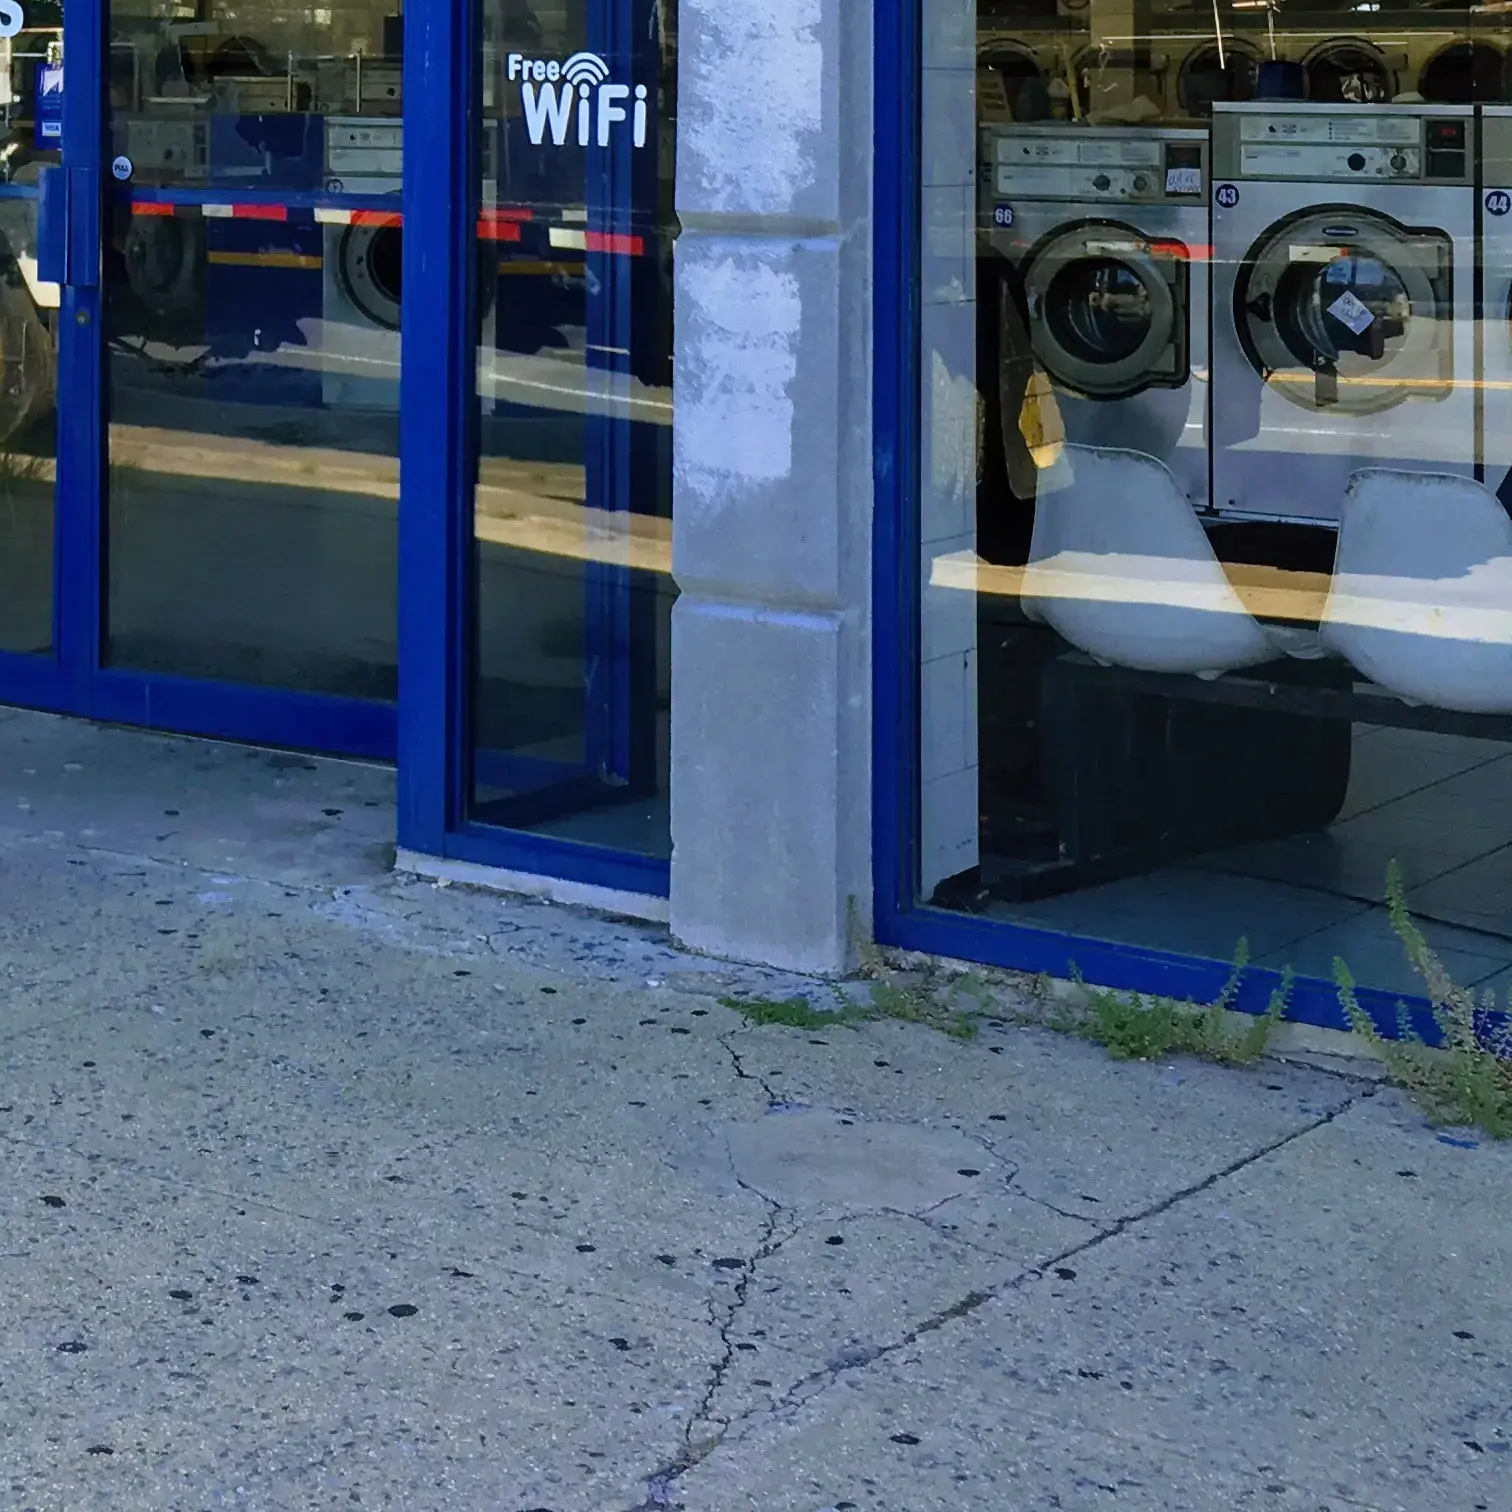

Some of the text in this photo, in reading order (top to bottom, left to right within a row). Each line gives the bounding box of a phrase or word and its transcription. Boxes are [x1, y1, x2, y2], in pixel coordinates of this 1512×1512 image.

[508, 53, 560, 81] Free
[522, 82, 648, 148] WiFi
[44, 123, 60, 132] VISA
[114, 164, 130, 172] PULL
[1218, 188, 1237, 204] 43
[1488, 195, 1508, 212] 44
[995, 208, 1013, 226] 66
